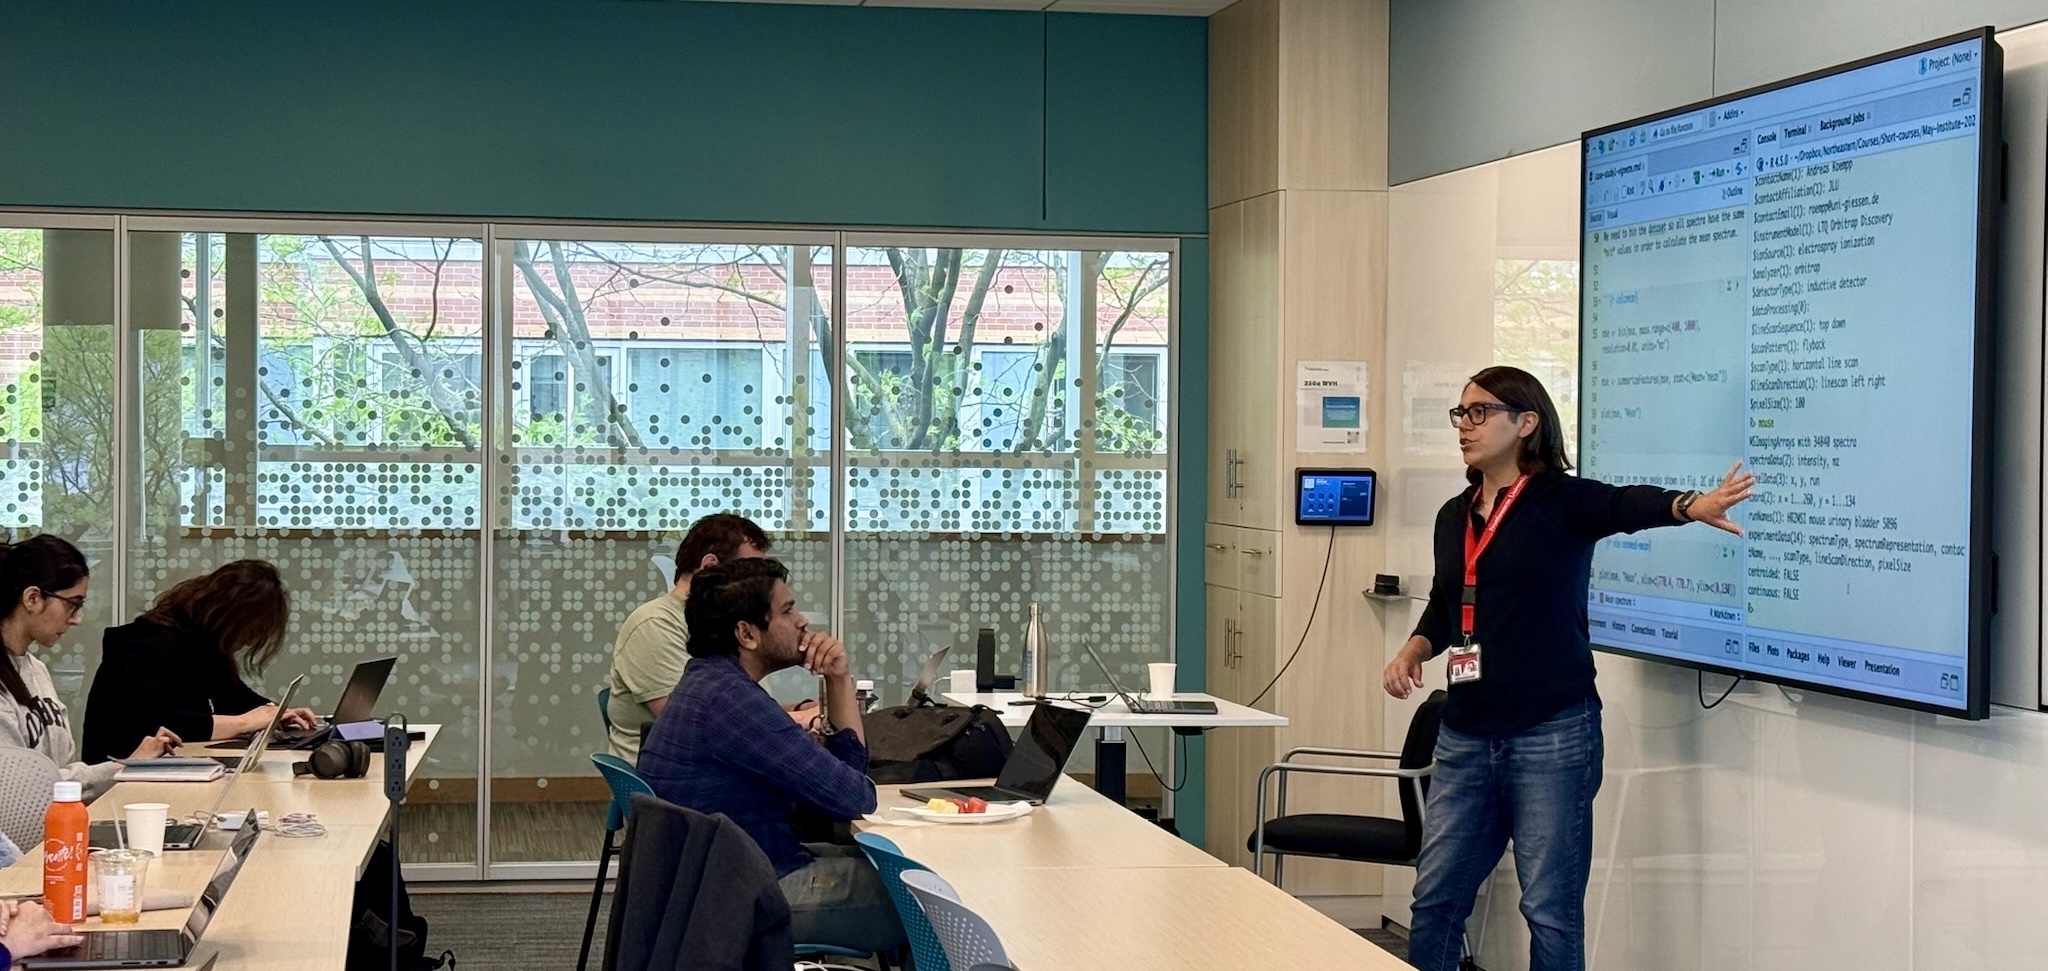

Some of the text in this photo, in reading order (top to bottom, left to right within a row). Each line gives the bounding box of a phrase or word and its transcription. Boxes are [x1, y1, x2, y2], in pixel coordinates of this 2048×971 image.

[1928, 50, 1972, 70] Project: (None)
[1724, 109, 1739, 120] Addins
[1784, 112, 1865, 139] Terminal Background Jobs
[1757, 130, 1777, 145] Console
[1806, 165, 1829, 177] Andreas
[1727, 186, 1743, 197] Outline
[1754, 179, 1840, 205] $contactAffiliation(1): JLU
[1638, 225, 1646, 236] the
[1676, 218, 1684, 229] all
[1686, 217, 1706, 229] spectra
[1708, 212, 1720, 224] have
[1722, 210, 1730, 221] the
[1733, 210, 1744, 220] same
[1754, 204, 1805, 224] $contactEmail(1):
[1817, 220, 1828, 235] LTQ
[1830, 216, 1858, 231] Orbitrap
[1860, 212, 1893, 227] Discovery
[1663, 236, 1687, 247] calculate
[1689, 234, 1697, 244] the
[1753, 235, 1875, 262] $ionSource(1): electrospray ionization
[1753, 262, 1821, 281] $analyzer(1): orbitrap
[1752, 276, 1867, 298] $detectorType(1): inductive detector
[1752, 317, 1846, 336] $lineScanSequence(1): top down
[1751, 338, 1826, 354] $scanPattern(1): flyback
[1751, 357, 1859, 375] $scanType(1): horizontal line scan
[1750, 374, 1886, 392] $lineScanDirection(1): linescan left right
[1750, 396, 1805, 412] $pixelSize(1): 100
[1758, 418, 1774, 429] mouse
[1798, 435, 1811, 448] with
[1833, 436, 1857, 449] spectra
[1749, 453, 1840, 469] spectraData(2): intensity, mz
[1810, 475, 1820, 486] run
[1748, 511, 1784, 525] runNames(1):
[1809, 515, 1826, 526] mouse
[1828, 515, 1852, 530] urinary
[1855, 515, 1880, 529] bladder
[1748, 530, 1965, 556] experimentData(14): spectrumType, spectrumRepresentation, contac
[1784, 550, 1812, 566] scanType,
[1815, 551, 1875, 571] lineScanDirection,
[1878, 558, 1911, 572] pixelSize
[1748, 566, 1800, 582] centroided: FALSE
[1748, 584, 1799, 600] continuous: FALSE
[1631, 624, 1656, 636] Connections
[1748, 642, 1900, 676] Files Plots Packages Help Viewer Presentation
